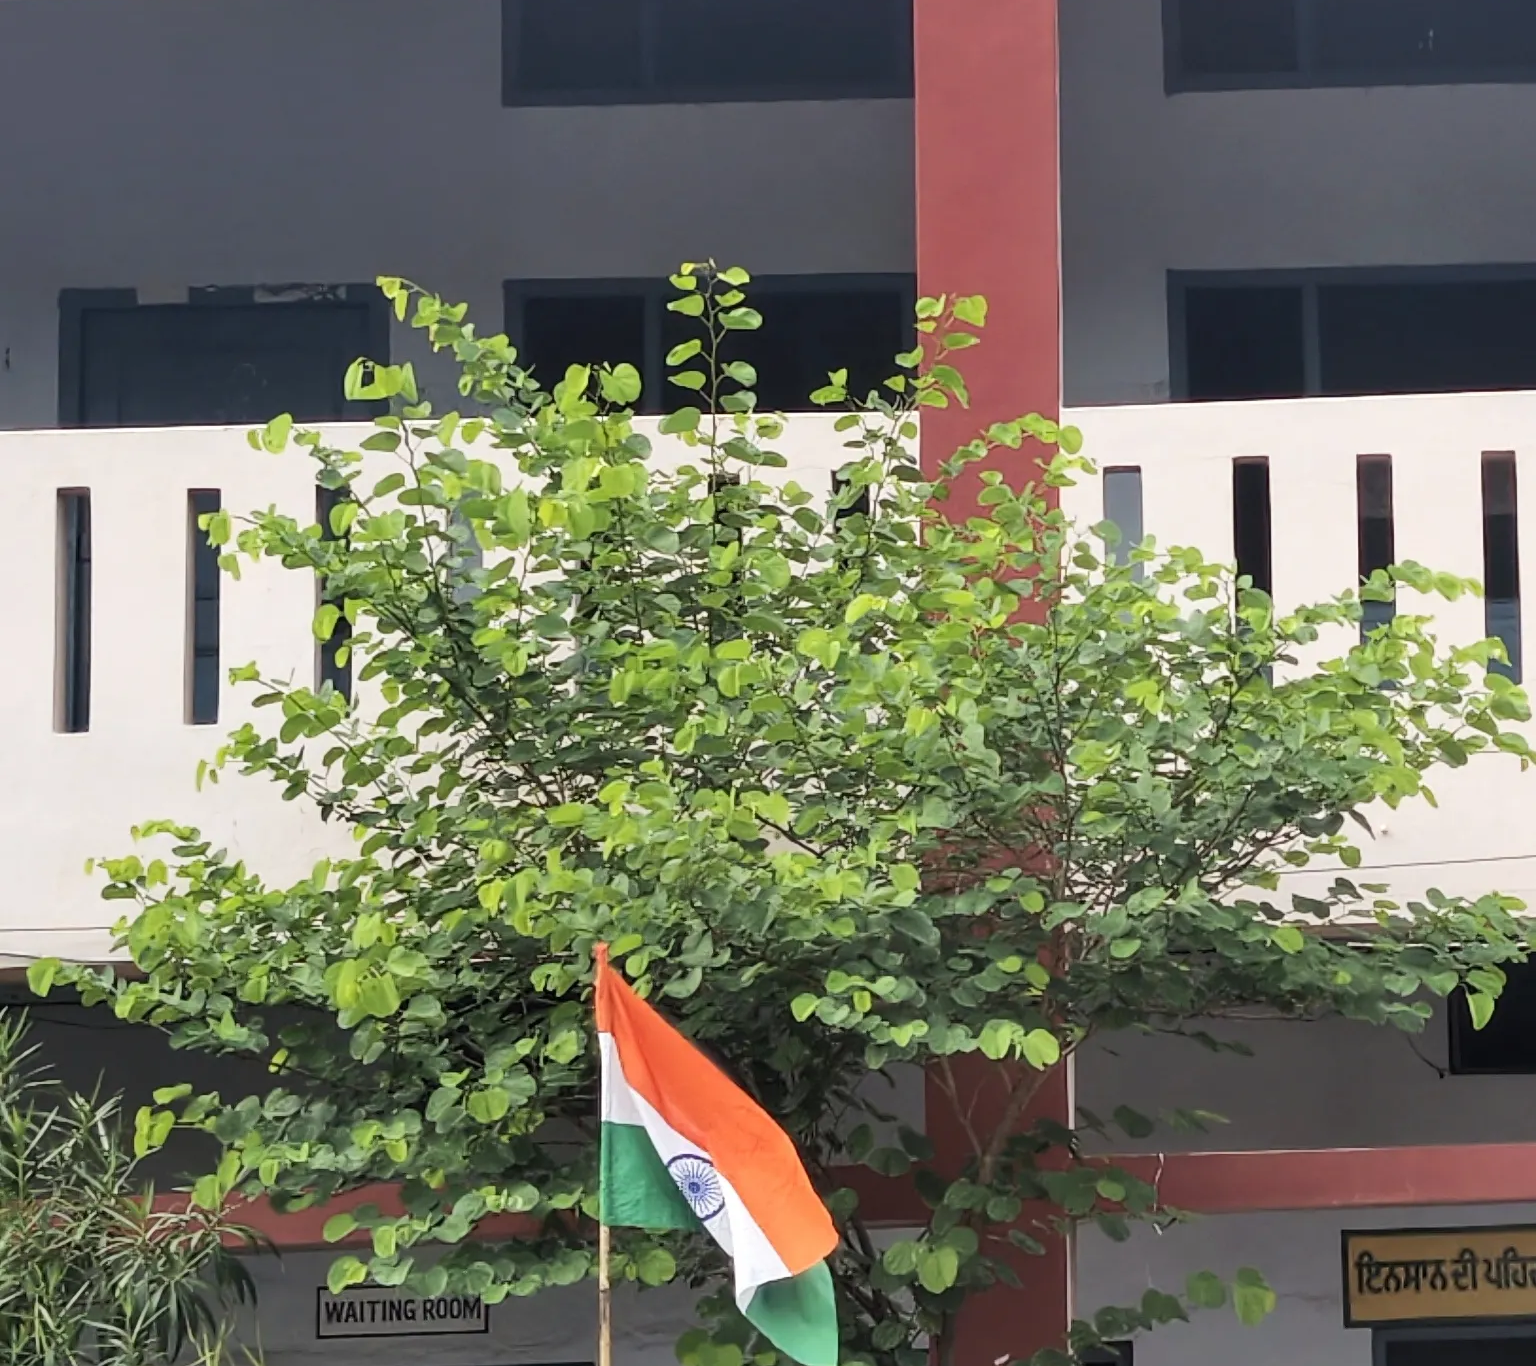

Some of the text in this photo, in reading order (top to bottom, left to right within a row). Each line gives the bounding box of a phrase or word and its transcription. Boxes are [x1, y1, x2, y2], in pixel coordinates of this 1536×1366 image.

[1451, 1247, 1478, 1292] ਦੀ
[324, 1295, 482, 1325] WAITING ROOM
